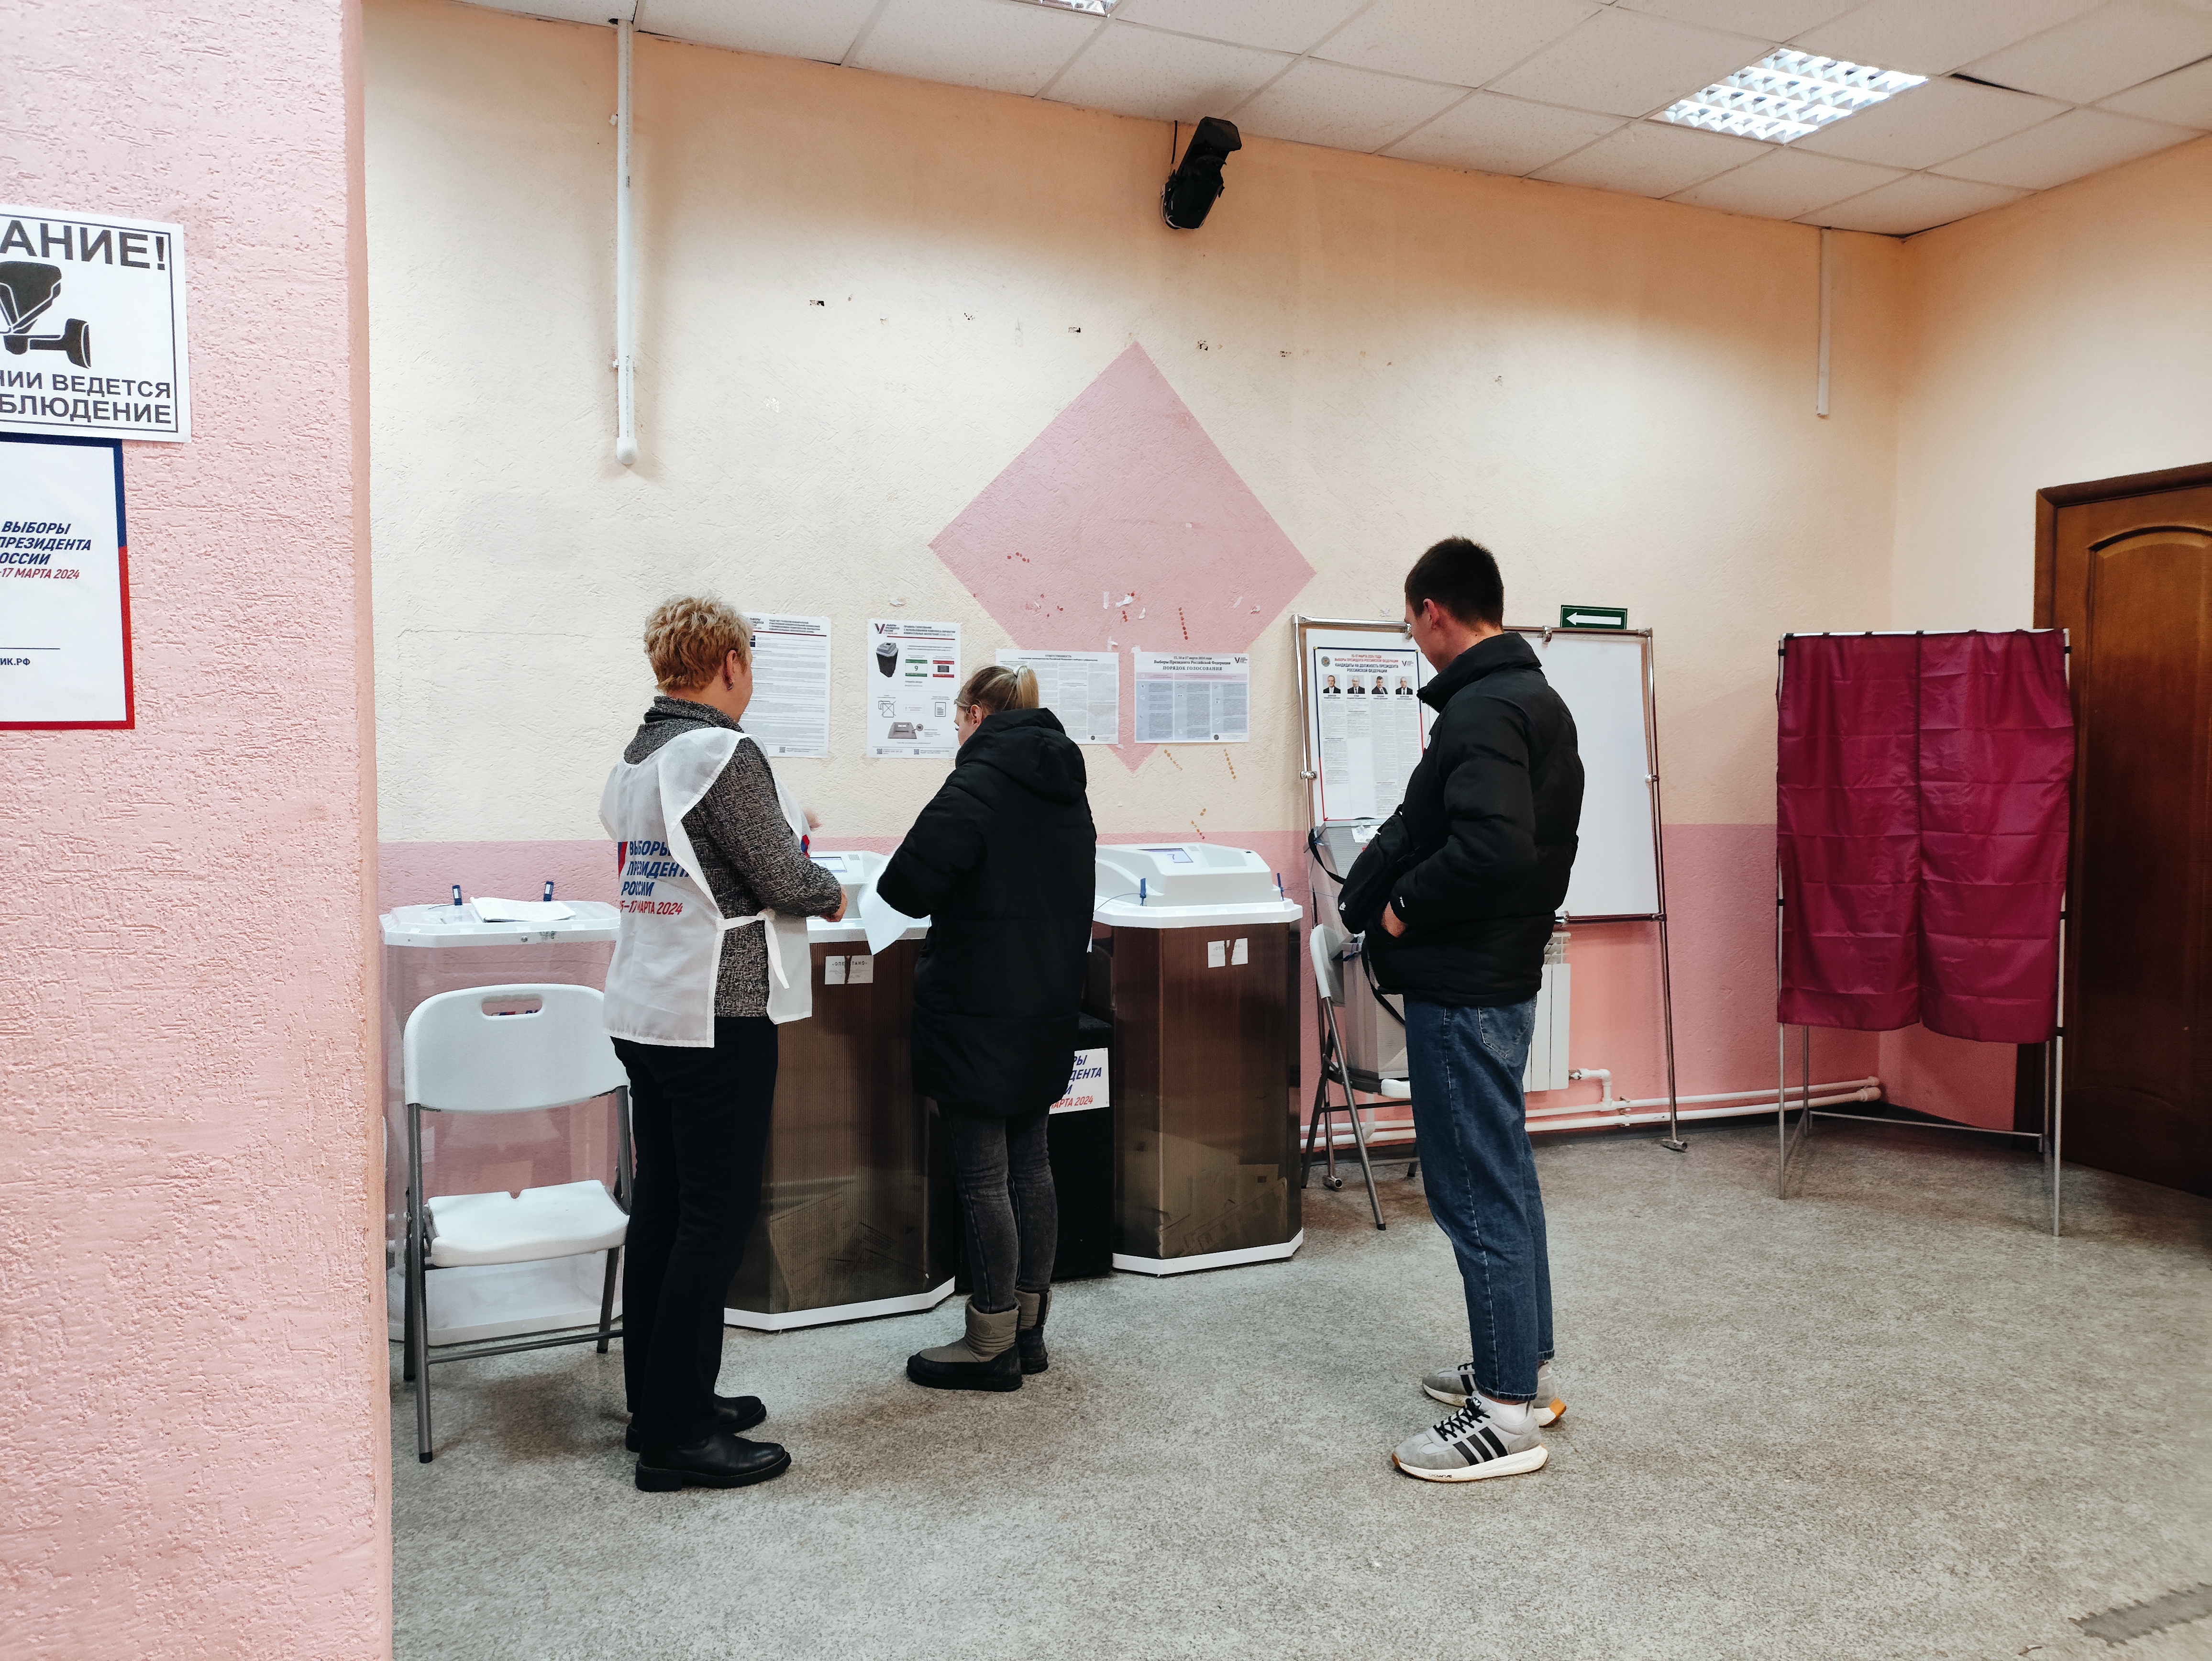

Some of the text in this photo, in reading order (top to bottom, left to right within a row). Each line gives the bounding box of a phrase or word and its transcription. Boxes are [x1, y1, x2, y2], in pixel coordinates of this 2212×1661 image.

[0, 220, 166, 271] АНИЕ!
[52, 374, 171, 399] ВЕДЕТСЯ
[0, 393, 171, 424] БЛЮДЕНИЕ
[1, 520, 71, 535] ВЫБОРЫ
[0, 536, 92, 552] ПРЕЗИДЕНТА
[14, 568, 52, 579] МАРТА
[54, 569, 80, 580] 2024
[0, 658, 31, 666] ИК.РФ
[627, 861, 689, 879] ПРЕЗИДЕНТ
[656, 902, 683, 915] 2024
[1074, 1095, 1094, 1107] 2024
